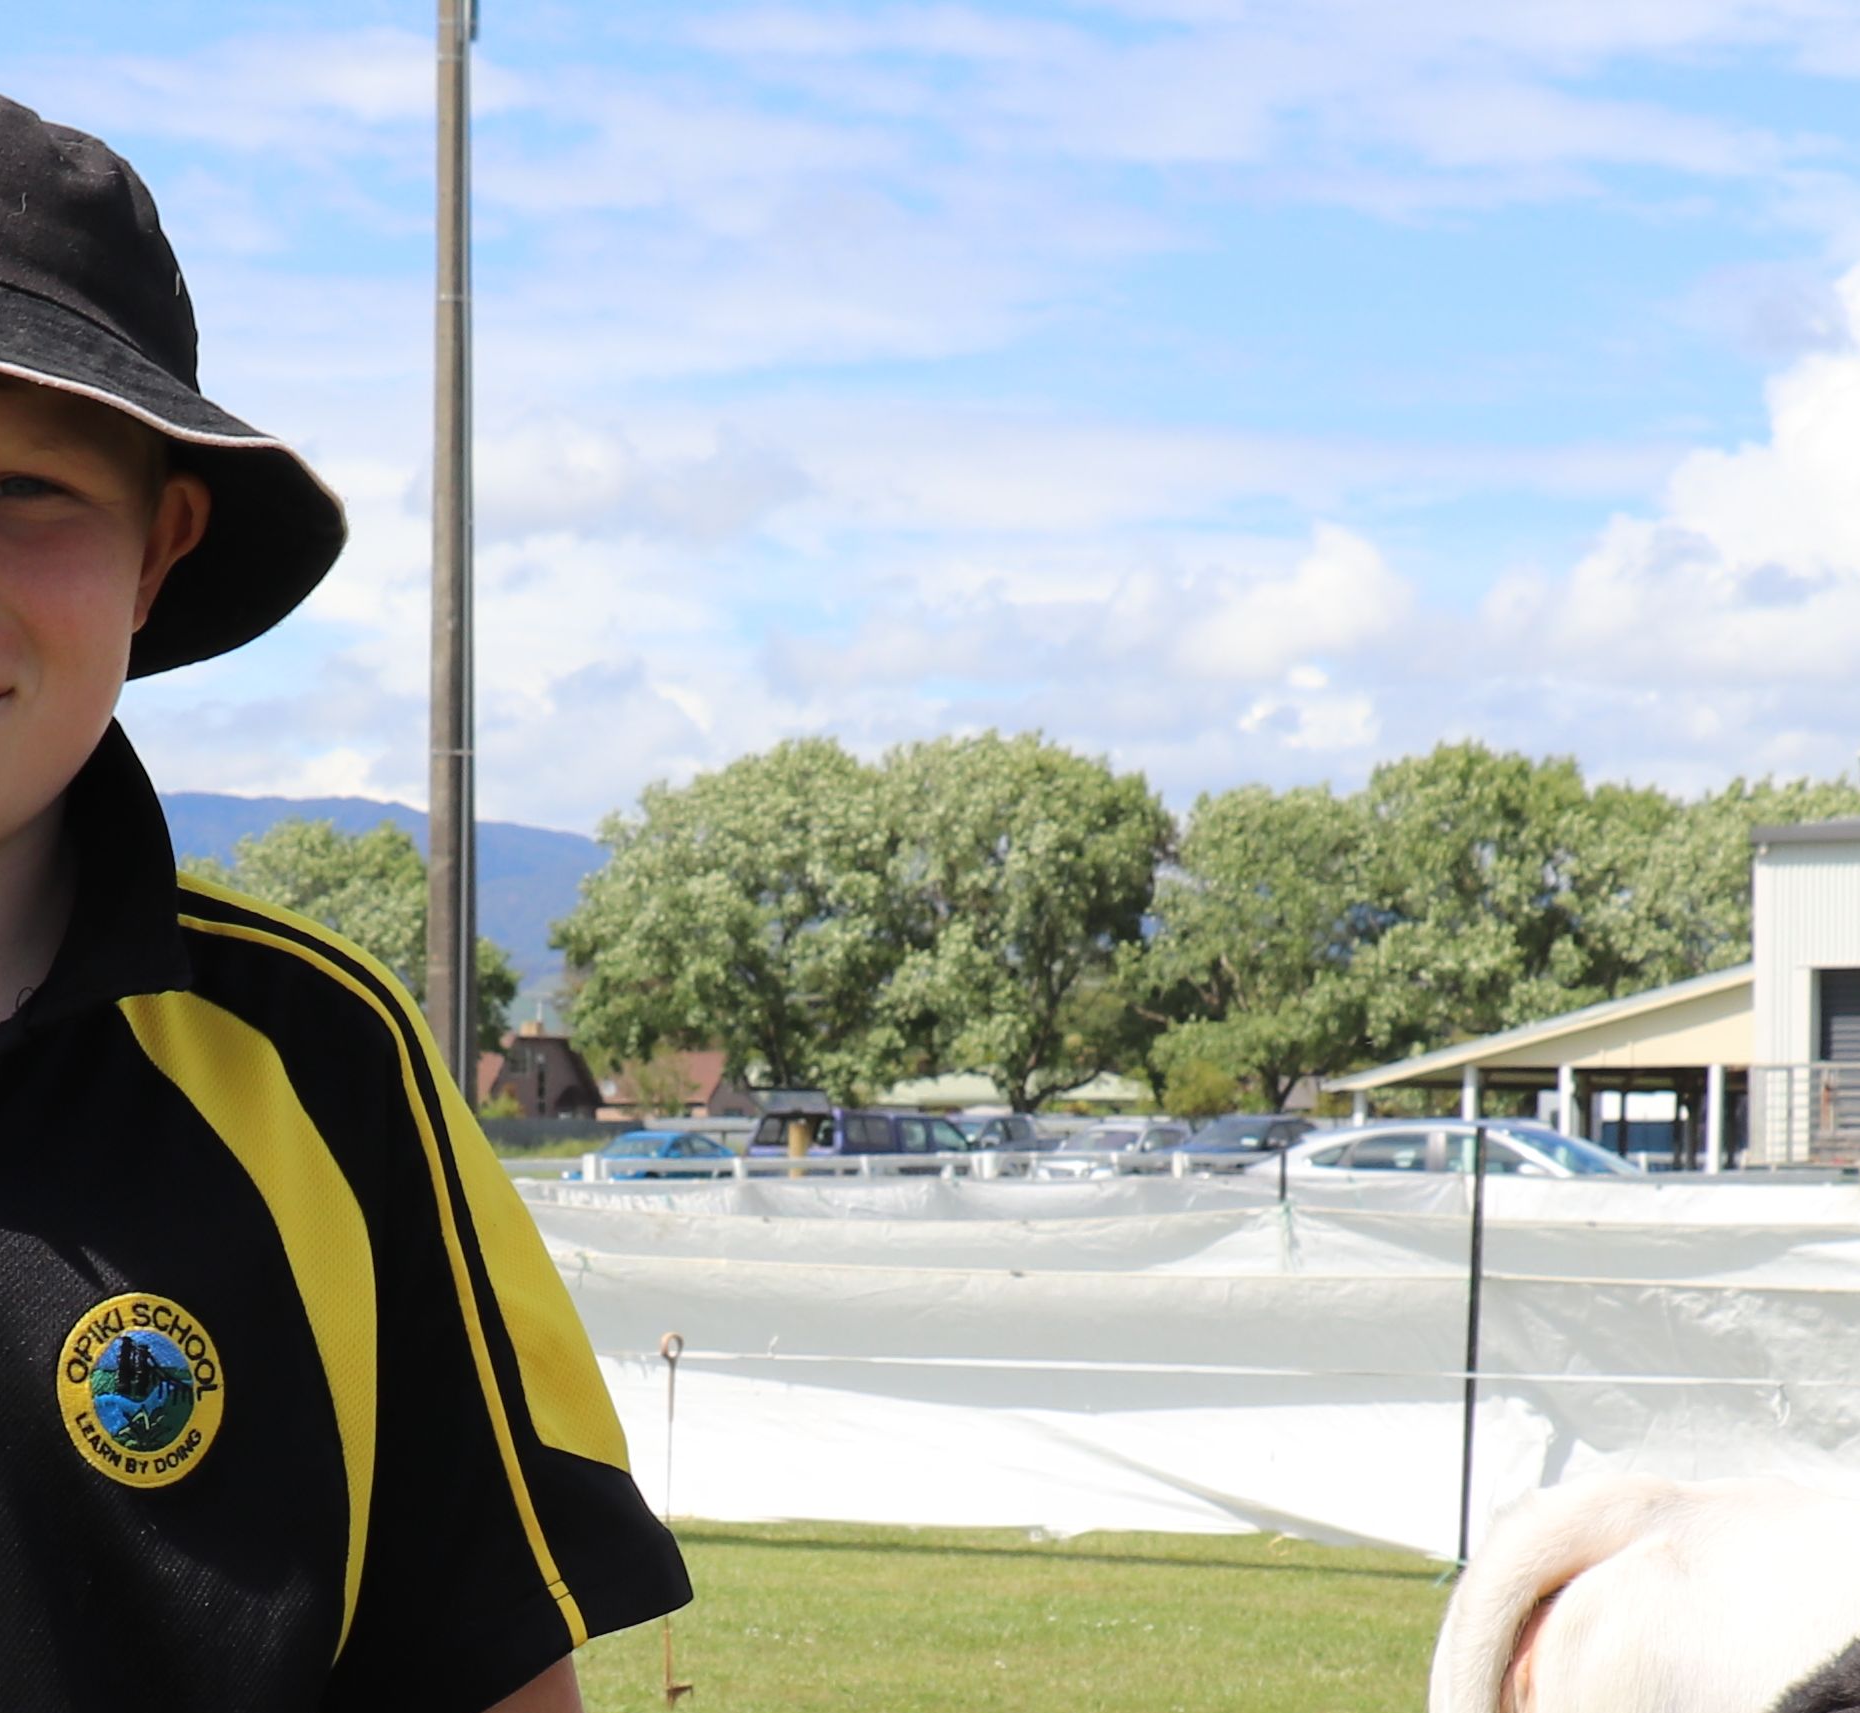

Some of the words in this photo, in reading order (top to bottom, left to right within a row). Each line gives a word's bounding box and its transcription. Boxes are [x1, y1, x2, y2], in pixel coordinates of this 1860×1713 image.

[66, 1308, 123, 1384] OPIKI
[132, 1303, 218, 1401] SCHOOL
[76, 1412, 122, 1467] LEARN
[125, 1456, 149, 1474] BY
[154, 1428, 202, 1474] DOING
